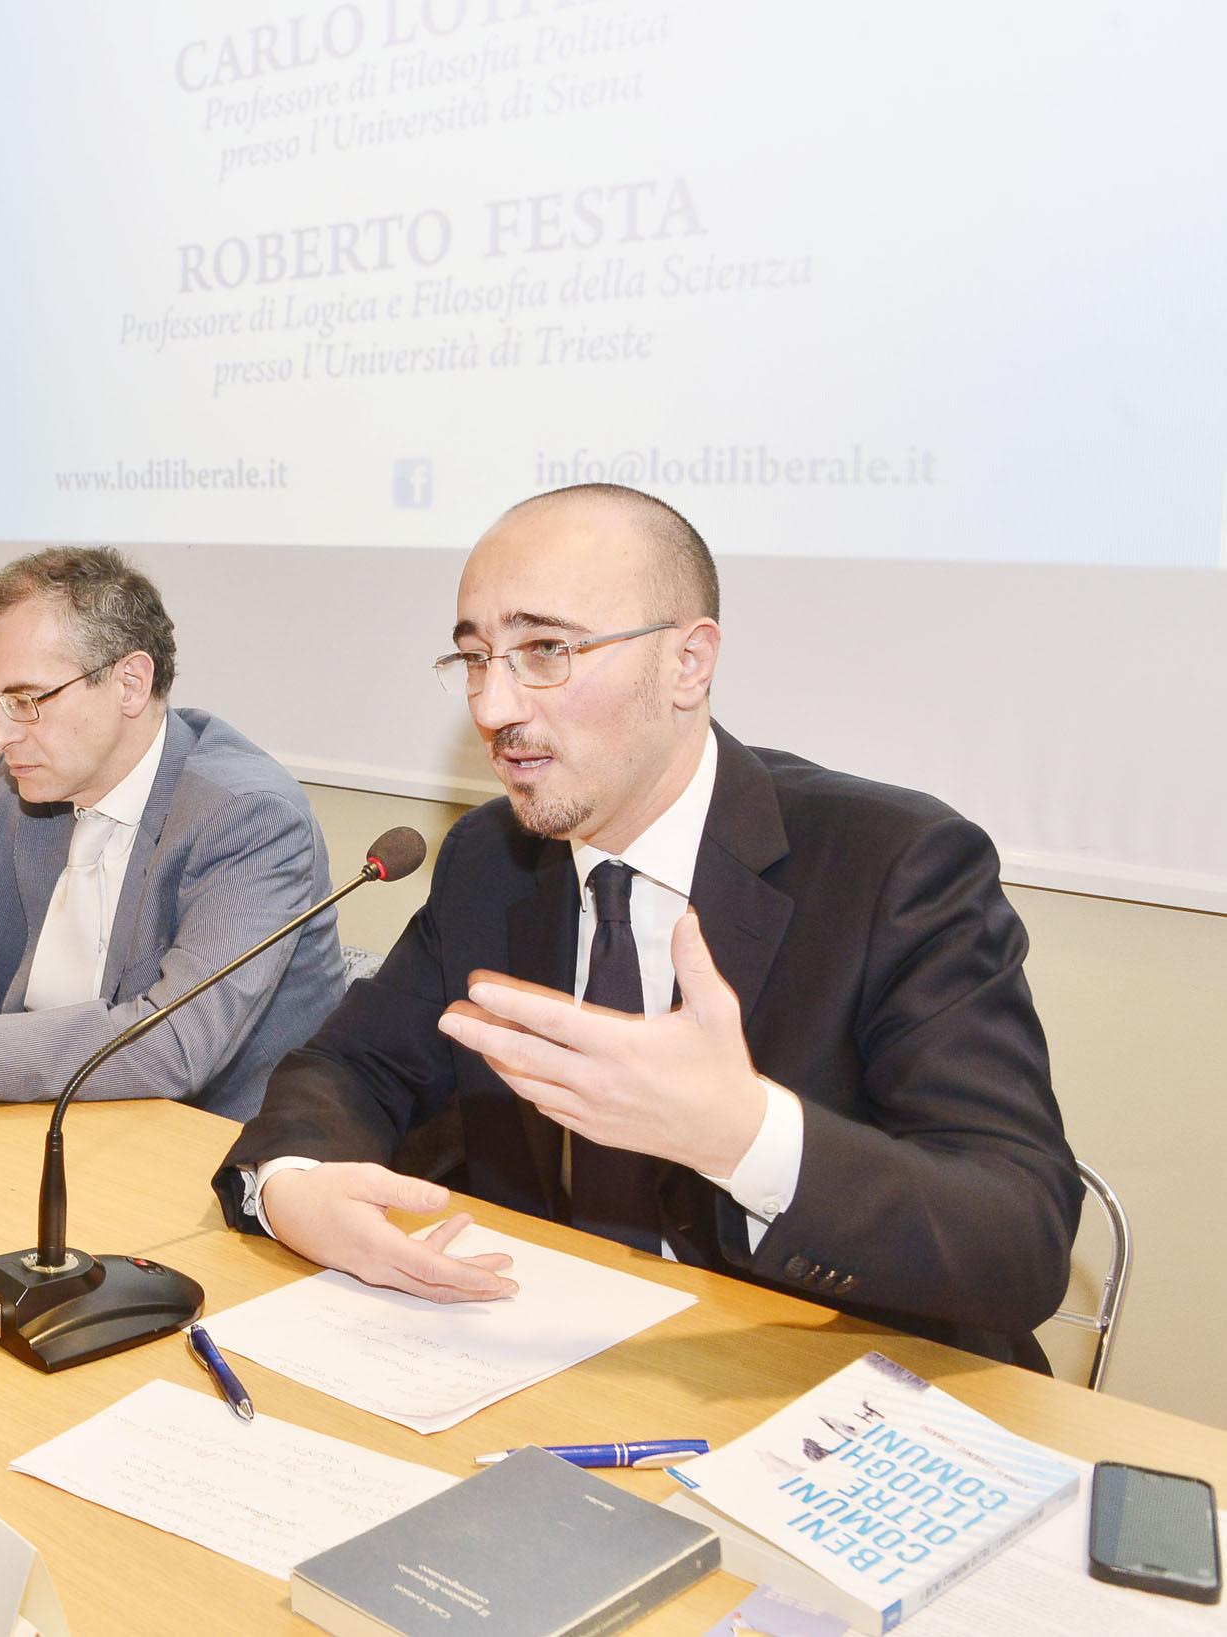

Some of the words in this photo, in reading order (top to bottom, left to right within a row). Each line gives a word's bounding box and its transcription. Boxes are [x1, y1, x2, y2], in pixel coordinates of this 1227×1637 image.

[174, 3, 366, 93] CARLO
[204, 79, 340, 136] Professore
[349, 63, 376, 103] di
[388, 36, 519, 97] Filosofia
[534, 11, 670, 65] Politica
[218, 131, 301, 184] presso
[501, 79, 533, 127] di
[544, 70, 645, 117] Siena
[177, 208, 452, 294] ROBERTO
[484, 176, 709, 260] FESTA
[120, 306, 242, 352] Professore
[249, 295, 275, 333] di
[284, 291, 377, 338] Logica
[387, 296, 401, 320] e
[413, 267, 548, 323] Filosofia
[560, 257, 646, 305] della
[660, 253, 813, 298] Scienza
[213, 356, 293, 398] presso
[489, 327, 523, 368] di
[536, 324, 653, 367] Trieste
[55, 457, 290, 492] www.lodiliberale.it
[535, 444, 938, 489] info@lodiliberale.it
[862, 1423, 1011, 1511] COMUNI
[778, 1476, 932, 1564] COMUNI
[787, 1512, 885, 1573] BENI
[837, 1477, 958, 1546] OLTRE
[962, 1512, 987, 1531] I
[878, 1566, 906, 1585] I
